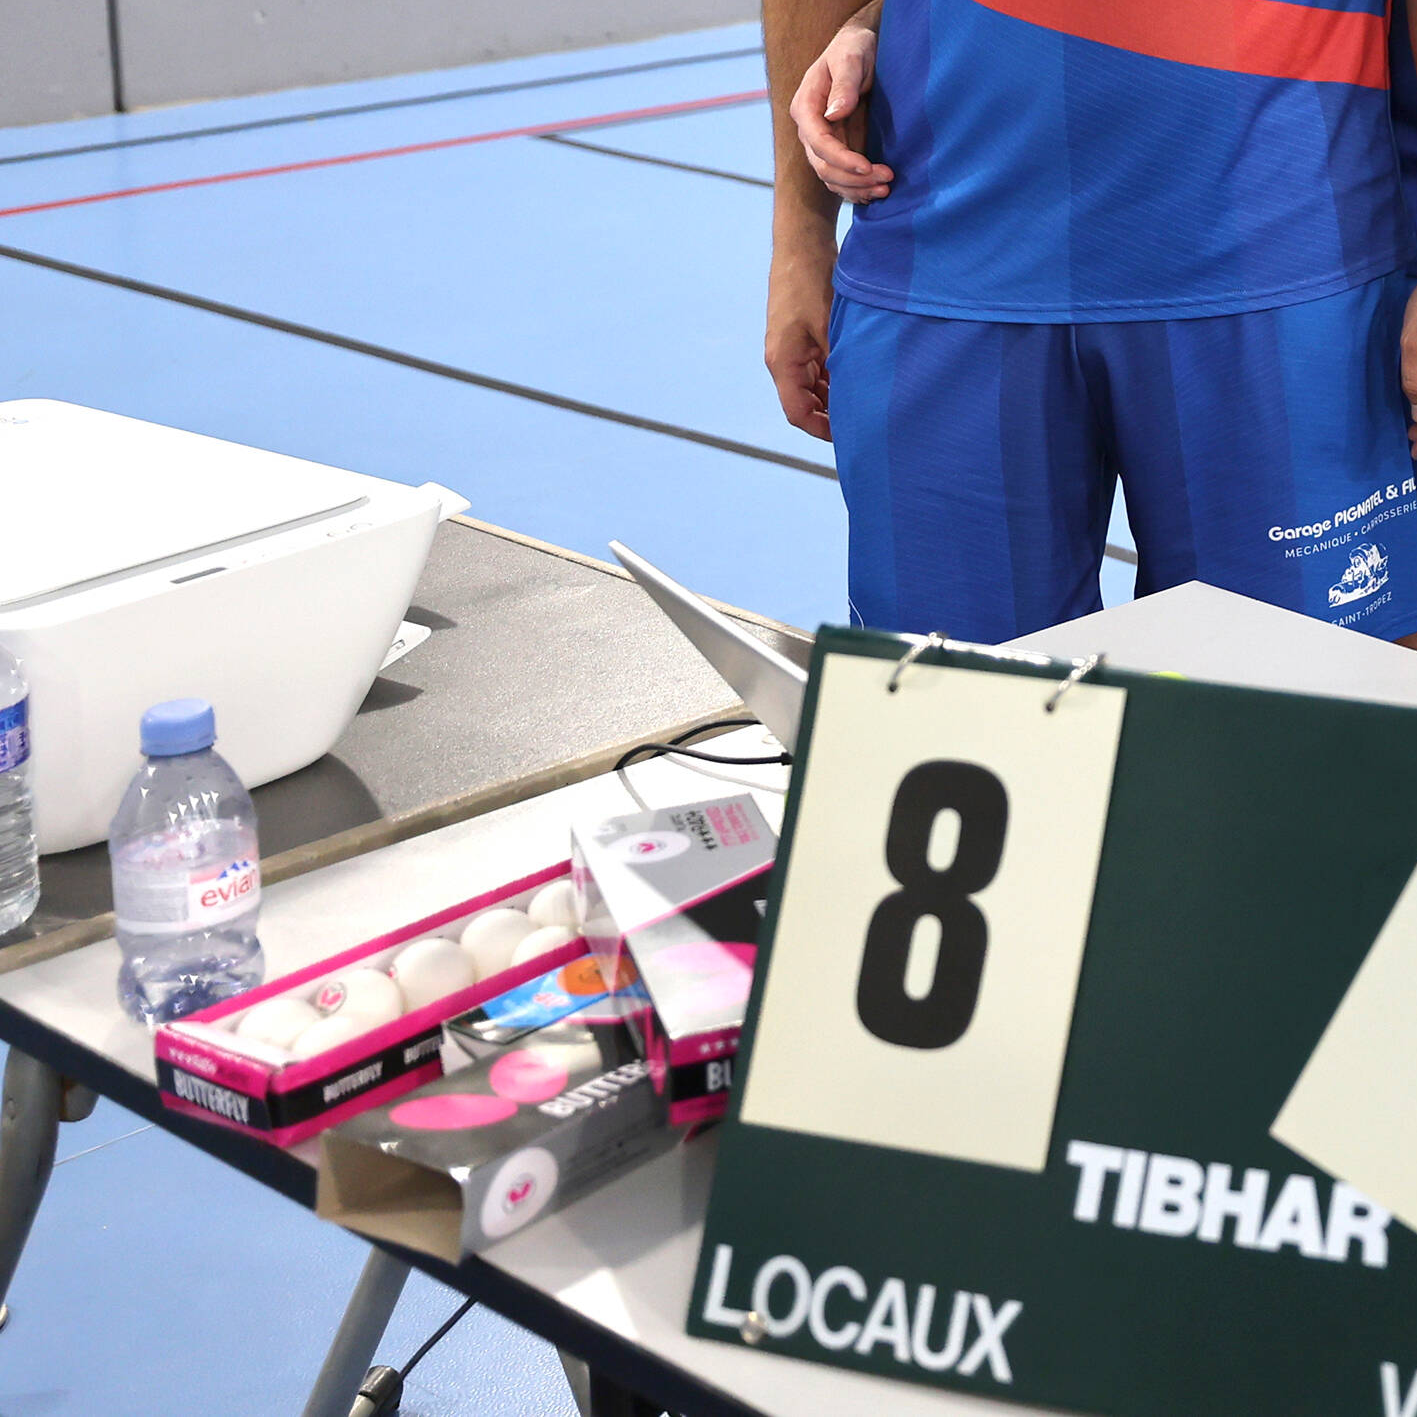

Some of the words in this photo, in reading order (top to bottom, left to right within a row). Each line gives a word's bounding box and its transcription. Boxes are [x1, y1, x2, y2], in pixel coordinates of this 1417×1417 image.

[1267, 518, 1332, 542] Garage
[1333, 489, 1384, 528] PIGNATEL
[1385, 483, 1399, 500] &
[1284, 532, 1352, 559] MECANIQUE
[856, 758, 1010, 1051] 8
[173, 1068, 249, 1125] BUTTERFLY
[1065, 1138, 1392, 1269] TIBHAR
[703, 1243, 1025, 1385] LOCAUX
